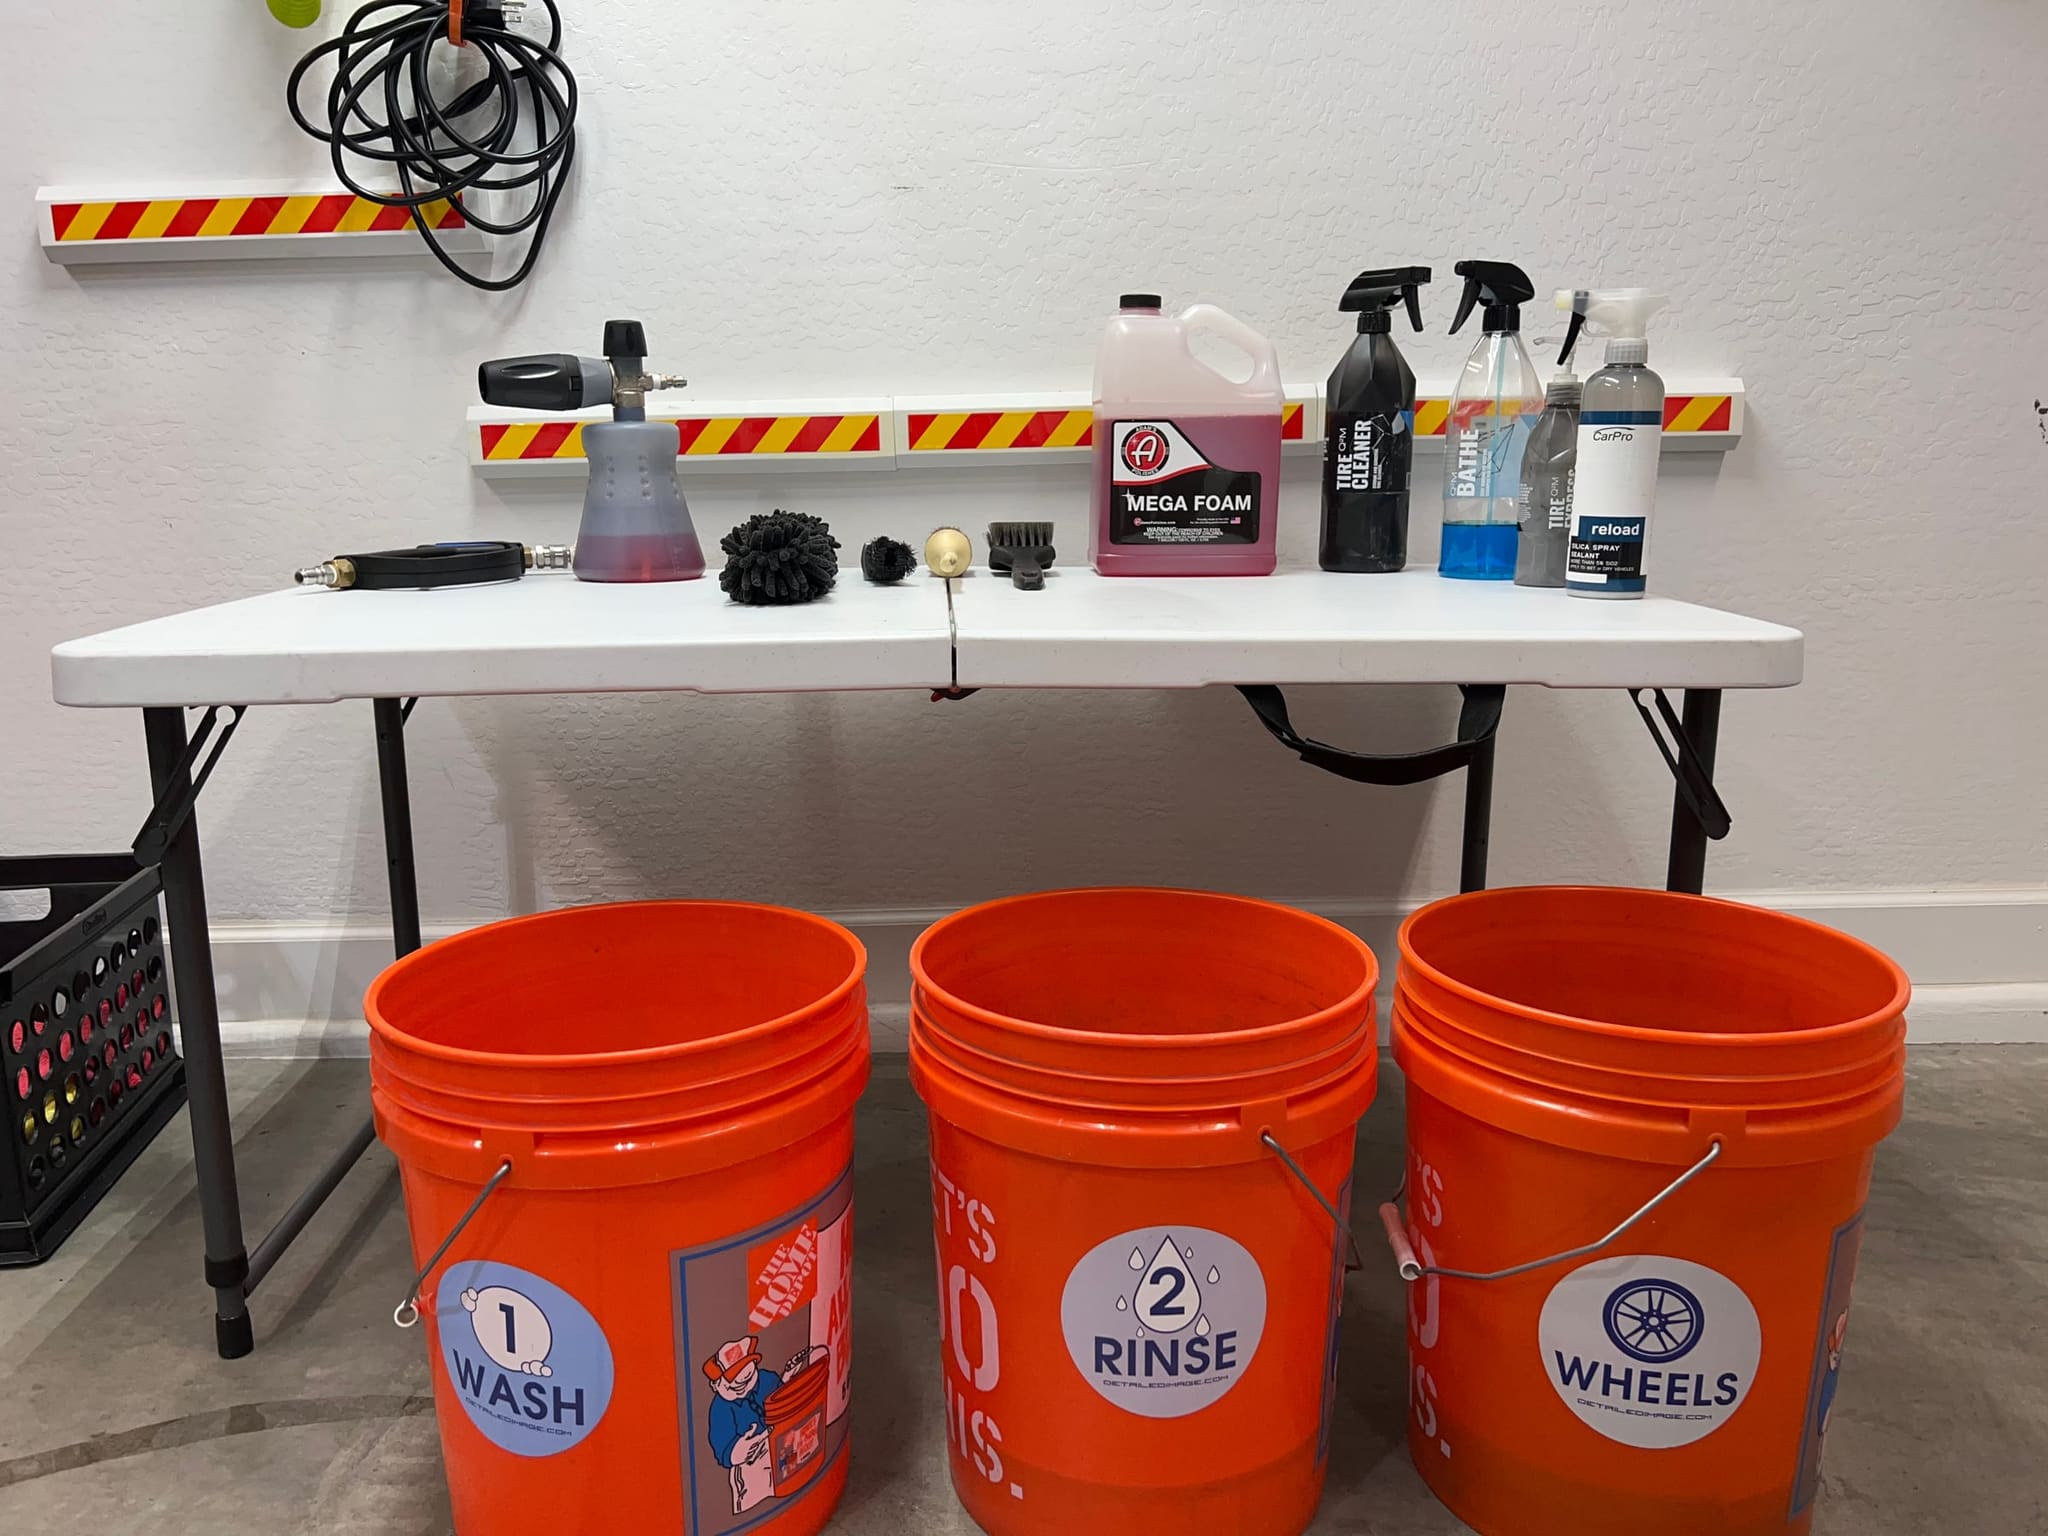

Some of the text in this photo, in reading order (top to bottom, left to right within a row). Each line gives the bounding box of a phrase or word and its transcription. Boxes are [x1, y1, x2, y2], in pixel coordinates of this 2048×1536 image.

[1131, 435, 1157, 466] A
[1352, 420, 1372, 490] CLEANER
[1593, 429, 1633, 442] CarPro
[1336, 454, 1352, 490] TIRE
[1457, 429, 1479, 497] BATHE
[1127, 494, 1251, 512] MEGA FOAM
[1548, 498, 1565, 529] TIRE
[1572, 543, 1620, 552] SILICA SPRAY
[1591, 523, 1640, 537] reload
[1570, 551, 1600, 559] SEALANT
[749, 1223, 817, 1328] HOME
[755, 1243, 790, 1286] THE
[779, 1243, 817, 1317] DEPOT
[1149, 1266, 1186, 1316] 2
[498, 1303, 516, 1354] 1
[1094, 1330, 1237, 1377] RINSE
[453, 1348, 584, 1426] WASH
[1102, 1375, 1229, 1389] DETAILEDIMAGE.COM
[1554, 1350, 1739, 1407] WHEELS
[1577, 1398, 1712, 1420] DETAILEDIMAGE.COM
